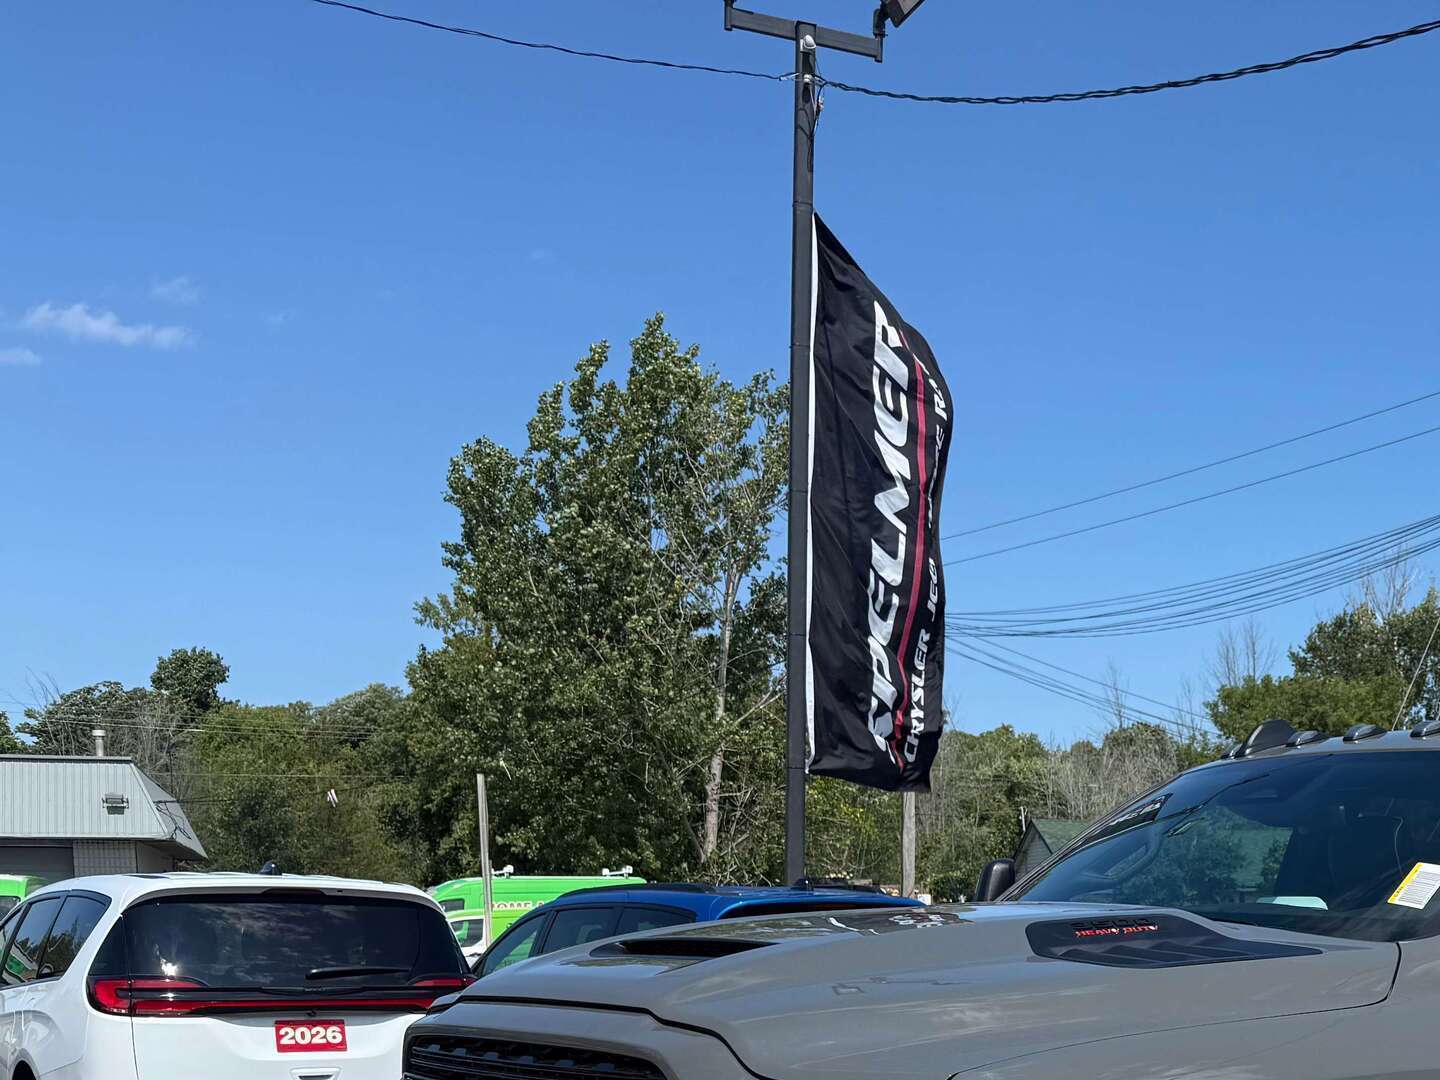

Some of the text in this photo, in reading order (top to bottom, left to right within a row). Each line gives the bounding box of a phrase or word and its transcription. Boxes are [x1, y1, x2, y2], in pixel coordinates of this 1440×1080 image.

[903, 628, 931, 763] CHRYSLER
[1075, 925, 1159, 937] HEAVY DUTY
[279, 1026, 343, 1045] 2026
